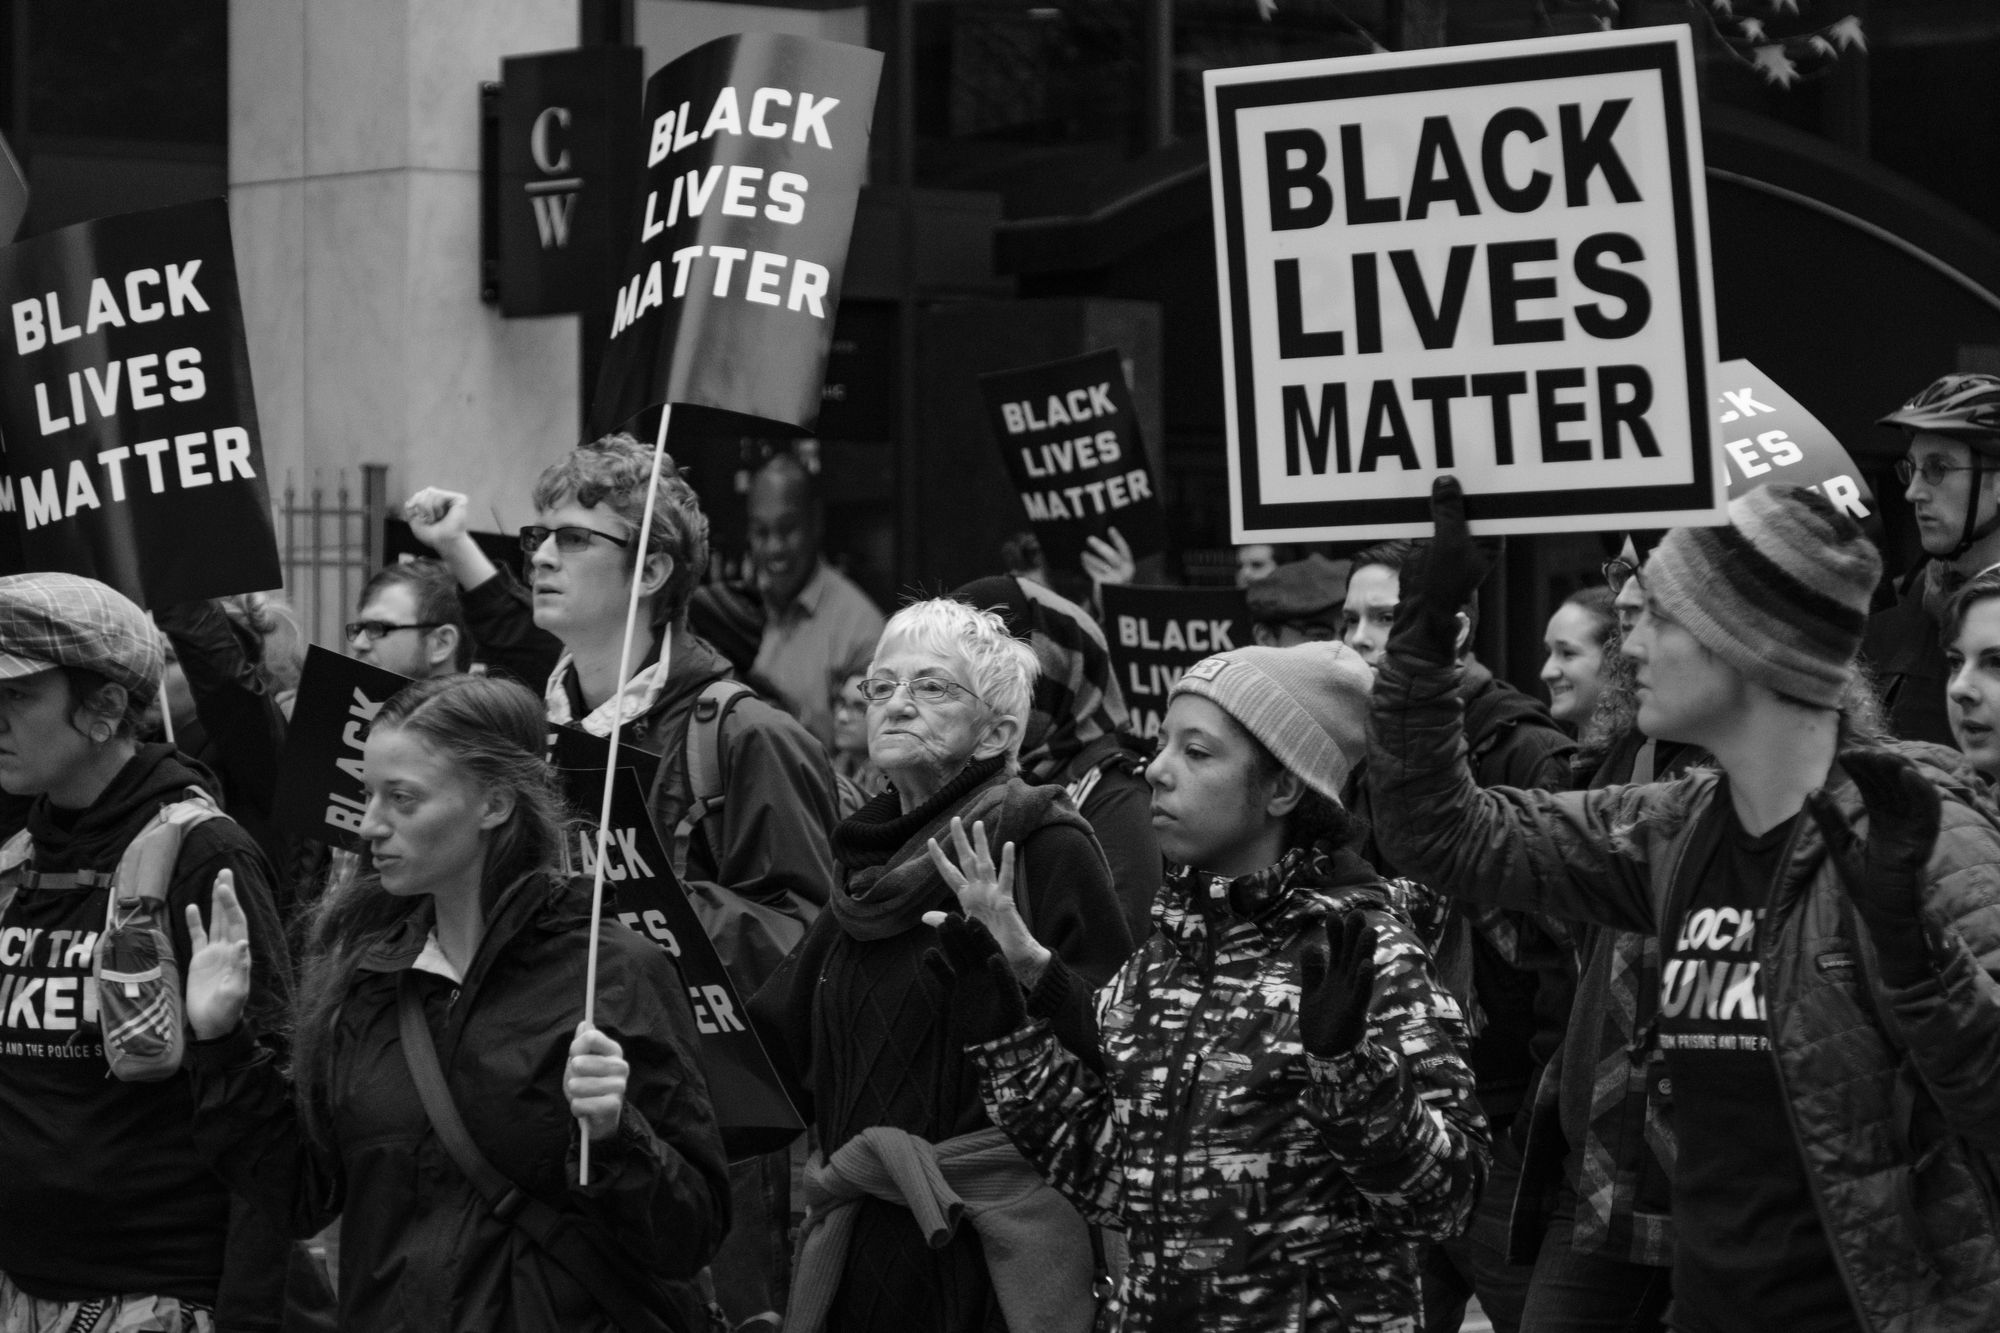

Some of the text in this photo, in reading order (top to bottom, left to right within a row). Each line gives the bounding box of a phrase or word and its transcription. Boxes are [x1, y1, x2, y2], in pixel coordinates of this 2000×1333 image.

[531, 106, 572, 174] C
[647, 86, 840, 168] BLACK
[1264, 97, 1645, 232] BLACK
[529, 193, 577, 249] W
[641, 165, 809, 244] LIVES
[12, 259, 210, 355] BLACK
[610, 245, 830, 339] MATTER
[1274, 231, 1653, 360] LIVES
[34, 347, 206, 435] LIVES
[1001, 382, 1118, 434] BLACK
[1282, 363, 1663, 476] MATTER
[20, 426, 256, 530] MATTER
[1021, 430, 1122, 478] LIVES
[1724, 429, 1803, 486] ES
[1021, 469, 1153, 520] MATTER
[1118, 615, 1235, 651] BLACK
[1129, 662, 1191, 695] LIV
[559, 828, 655, 881] LACK
[0, 927, 44, 967] CK
[1660, 958, 1768, 1021] UNK
[6, 1042, 23, 1056] AND
[26, 1043, 44, 1057] THE
[48, 1044, 89, 1058] POLICE
